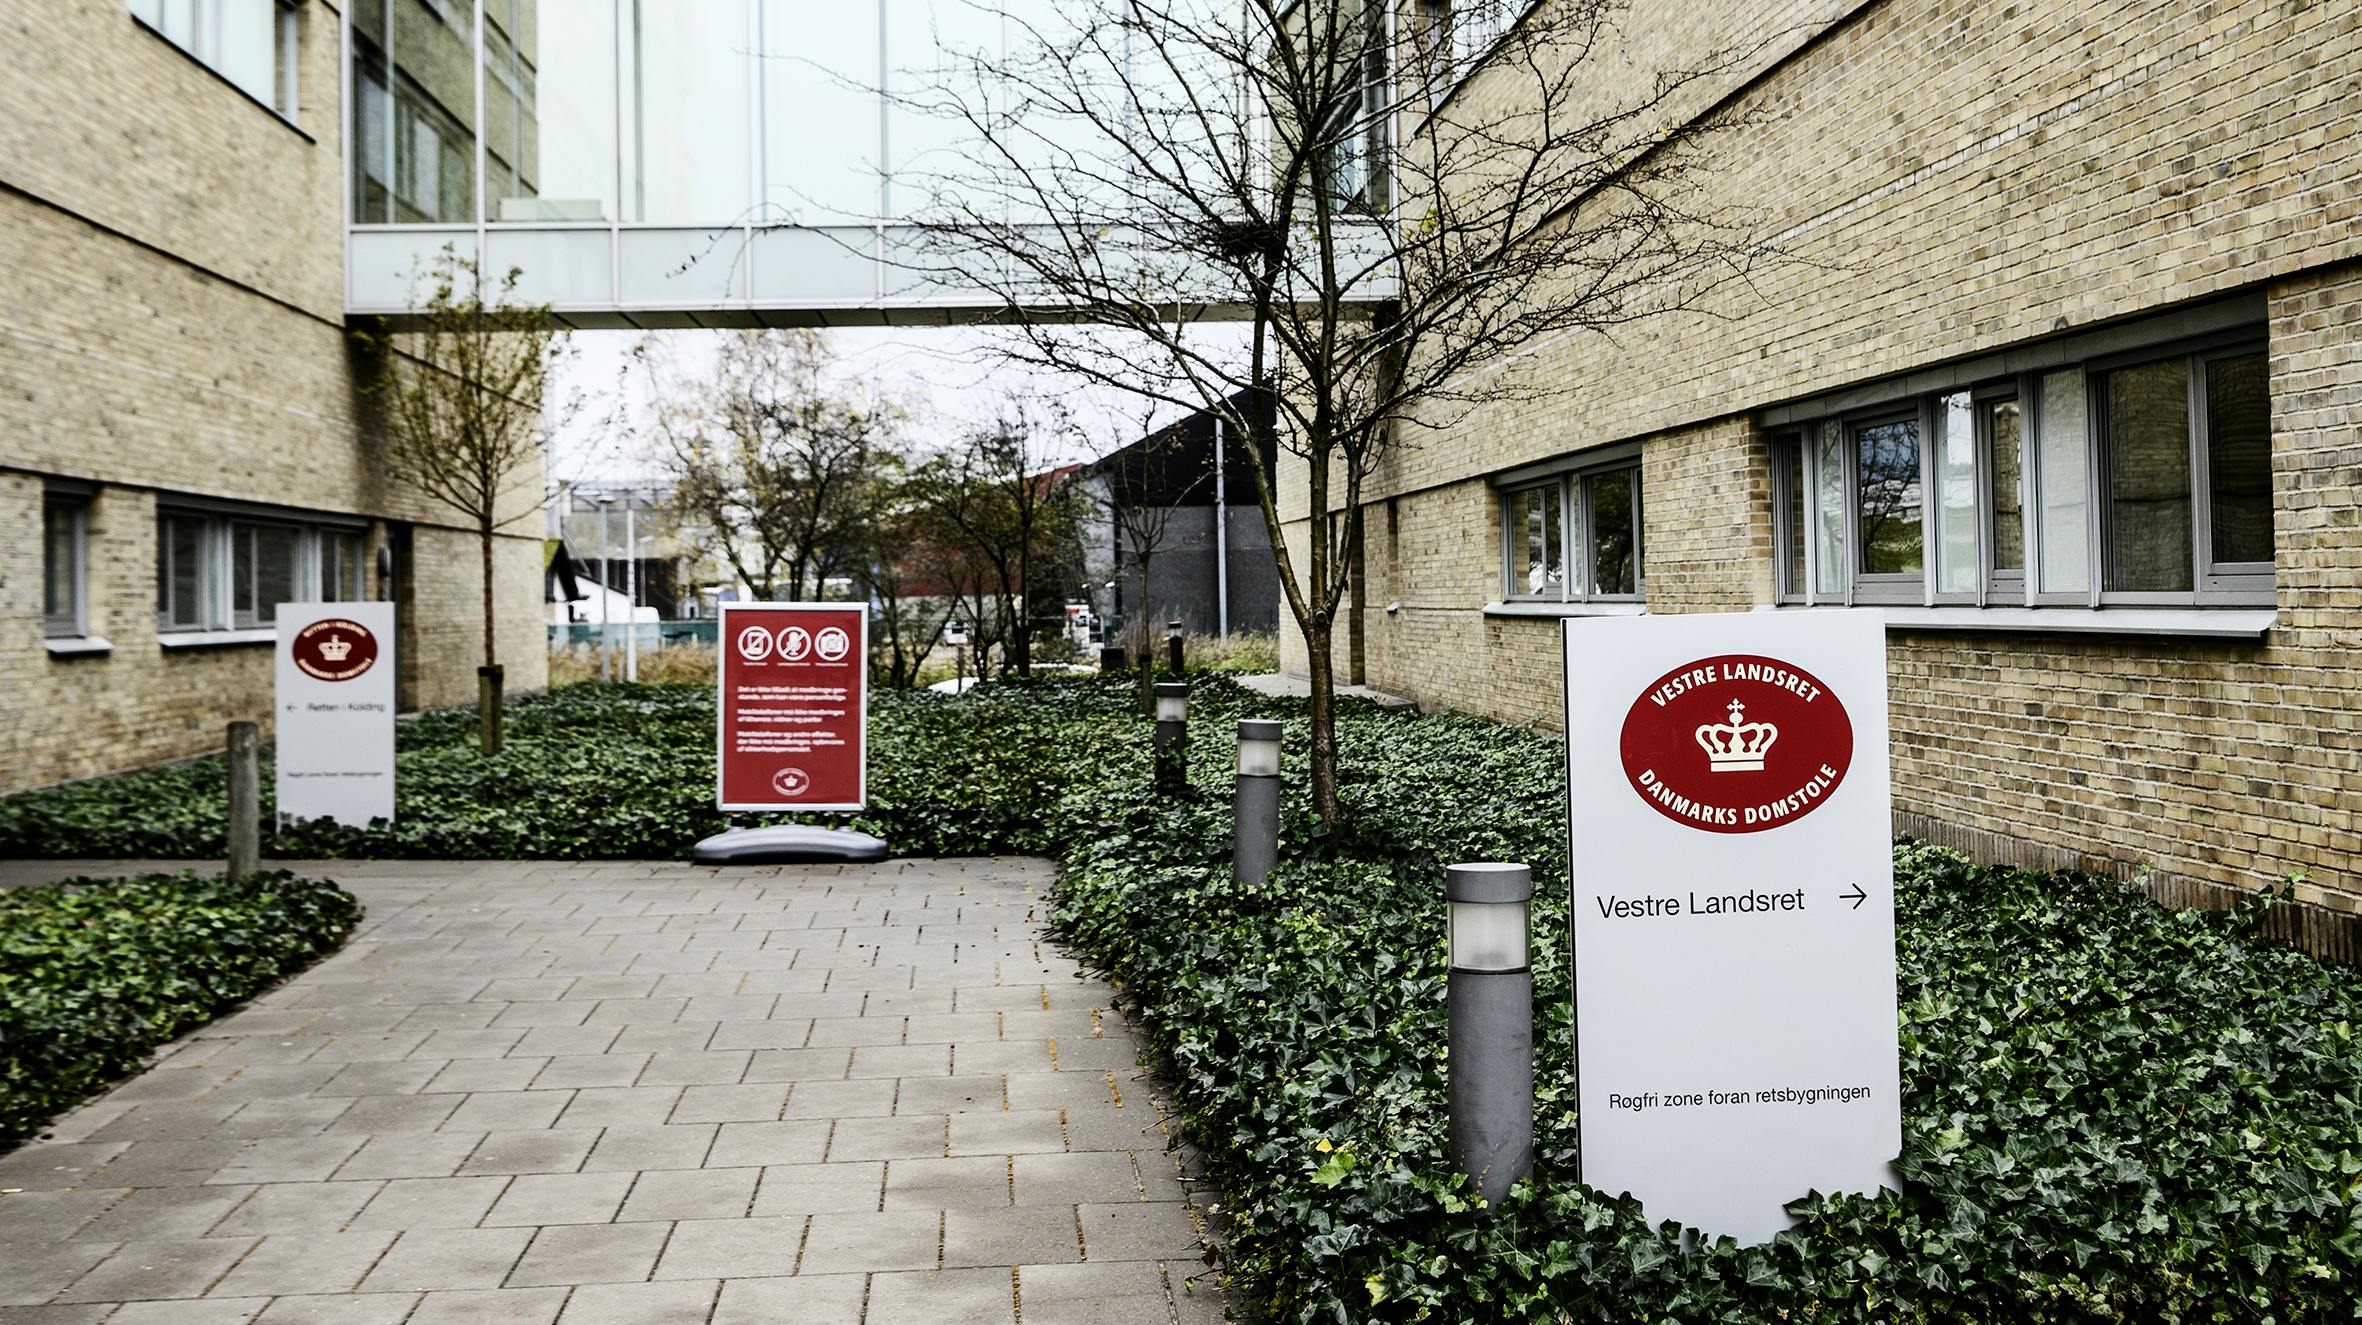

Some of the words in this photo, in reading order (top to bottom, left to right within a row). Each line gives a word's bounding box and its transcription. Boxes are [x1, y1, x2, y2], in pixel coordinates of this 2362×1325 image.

[1650, 665, 1717, 707] VESTRE
[1723, 663, 1821, 703] LANDSRET
[1638, 768, 1737, 825] DANMARKS
[1744, 763, 1838, 824] DOMSTOLE
[1596, 894, 1680, 919] Vestre
[1689, 888, 1805, 915] Landsret
[1609, 1092, 1659, 1112] Røgfri
[1663, 1094, 1704, 1107] zone
[1707, 1089, 1750, 1105] foran
[1755, 1086, 1871, 1106] retsbygningen
